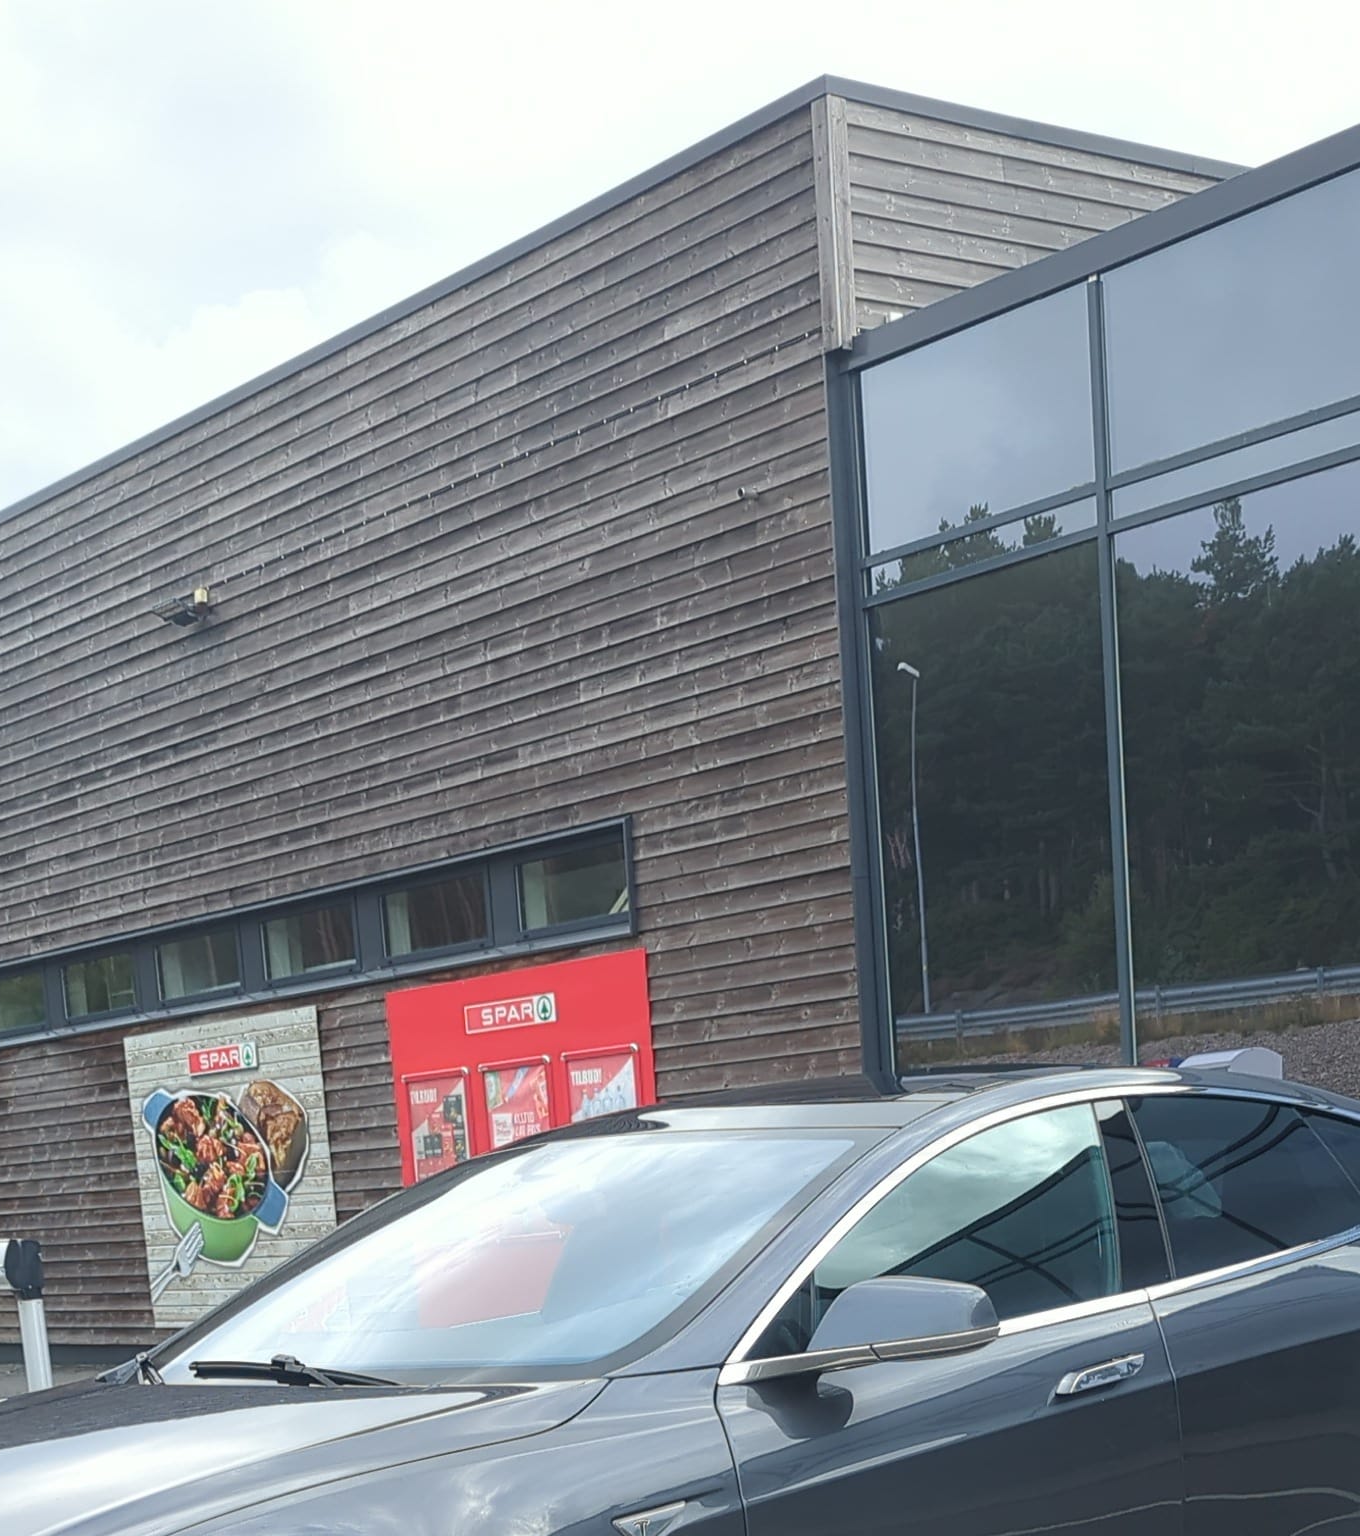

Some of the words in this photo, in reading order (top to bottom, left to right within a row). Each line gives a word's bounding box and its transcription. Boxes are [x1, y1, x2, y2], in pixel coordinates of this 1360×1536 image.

[481, 1002, 533, 1026] SPAR
[198, 1049, 240, 1070] SPAR
[570, 1068, 602, 1086] TILBUD!
